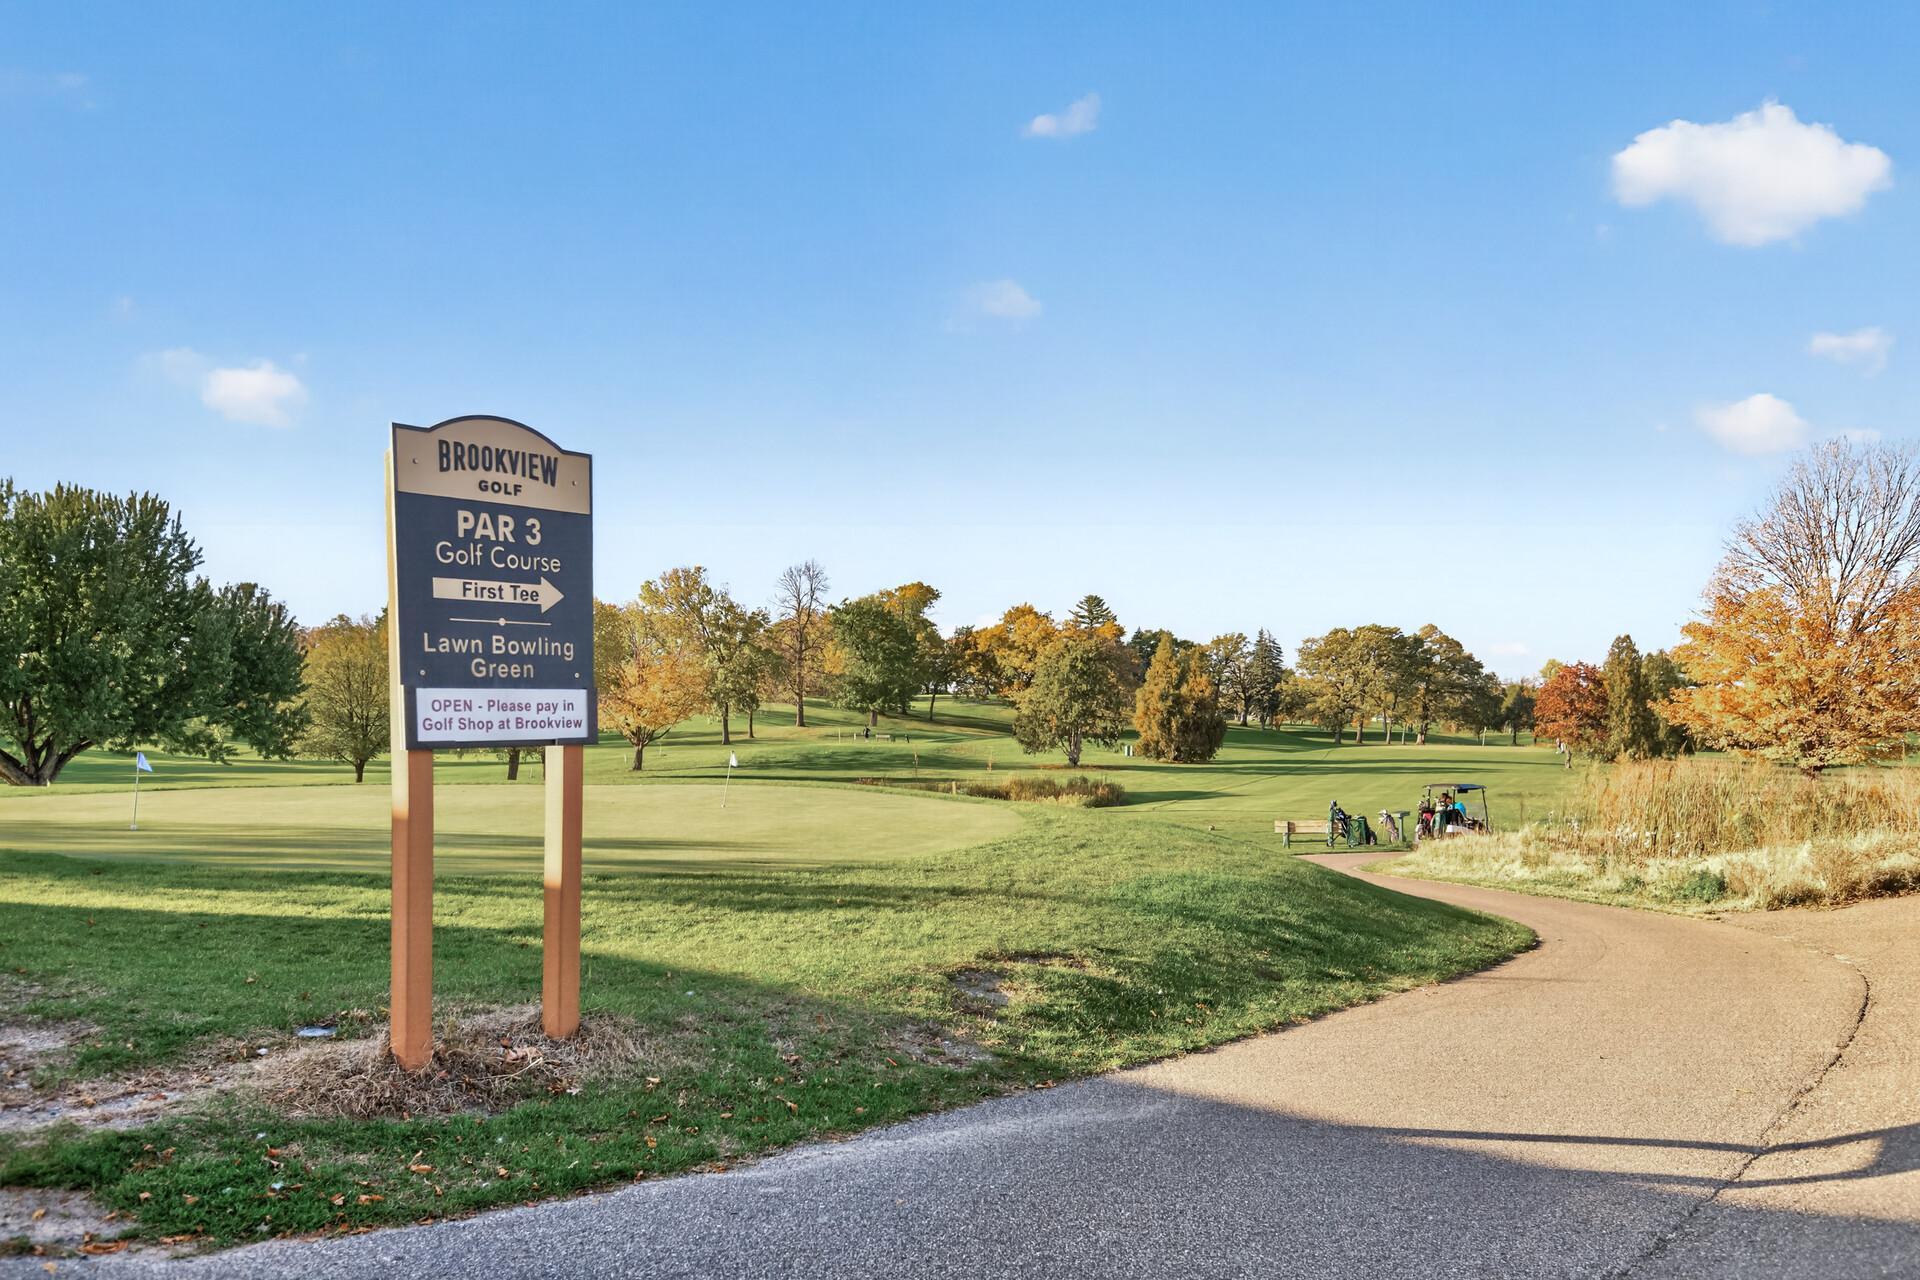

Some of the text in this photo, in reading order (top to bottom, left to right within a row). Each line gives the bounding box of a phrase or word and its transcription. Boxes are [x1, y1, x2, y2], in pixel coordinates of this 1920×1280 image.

[438, 439, 558, 487] BROOKVIEW
[478, 480, 522, 496] GOLF
[457, 510, 542, 545] PAR 3
[436, 541, 561, 573] Golf Course
[462, 581, 540, 602] First Tee
[424, 632, 574, 660] Lawn Bowling
[471, 658, 534, 678] Green
[431, 699, 473, 712] OPEN
[488, 700, 531, 712] Please
[537, 702, 559, 715] pay
[563, 700, 574, 711] in
[422, 717, 582, 732] Golf Shop at Brookview
